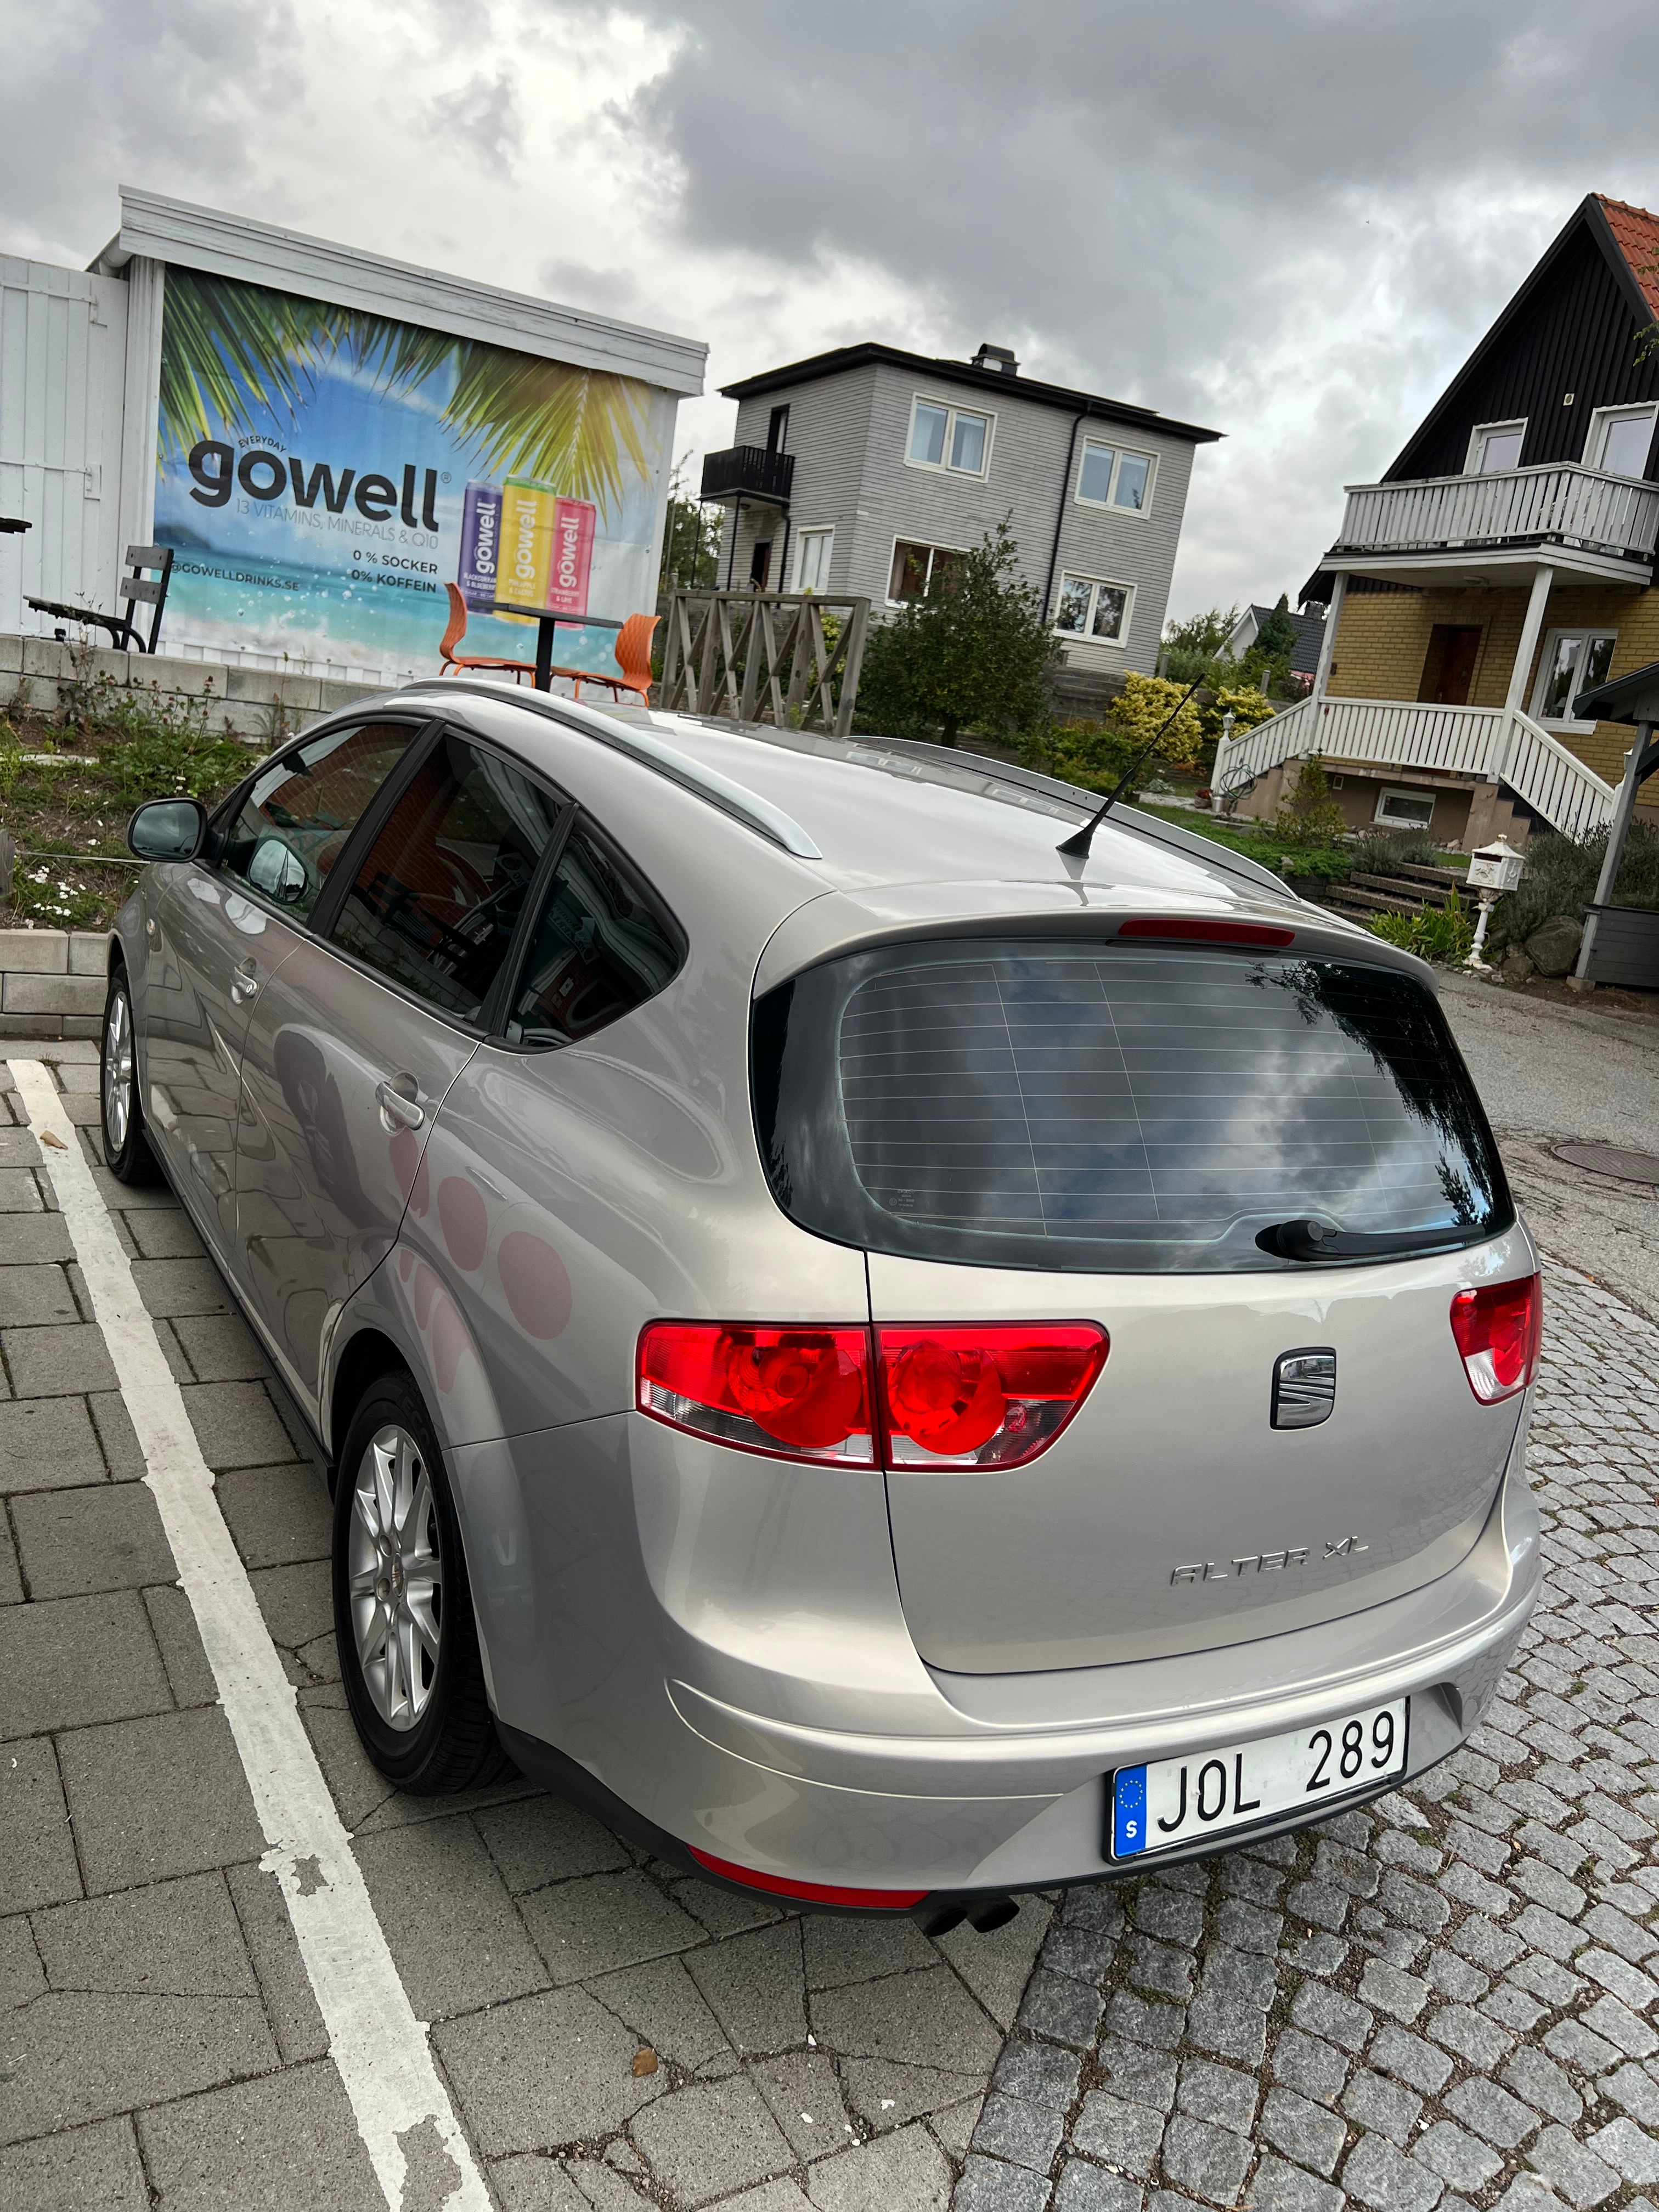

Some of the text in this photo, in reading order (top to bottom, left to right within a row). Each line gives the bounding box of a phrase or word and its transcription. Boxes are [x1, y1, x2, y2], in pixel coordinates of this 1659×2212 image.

[238, 435, 287, 453] EVERYDAY
[236, 498, 439, 549] 13 VITAMINS, MINERALS & Q10
[366, 552, 377, 563] %
[382, 555, 438, 574] SOCKER
[171, 561, 300, 591] @GOWELLDRINKS.SE
[352, 569, 437, 593] 0% KOFFEIN
[1323, 1536, 1369, 1560] XL
[1157, 1710, 1394, 1832] JOL 289
[1126, 1820, 1137, 1839] S
